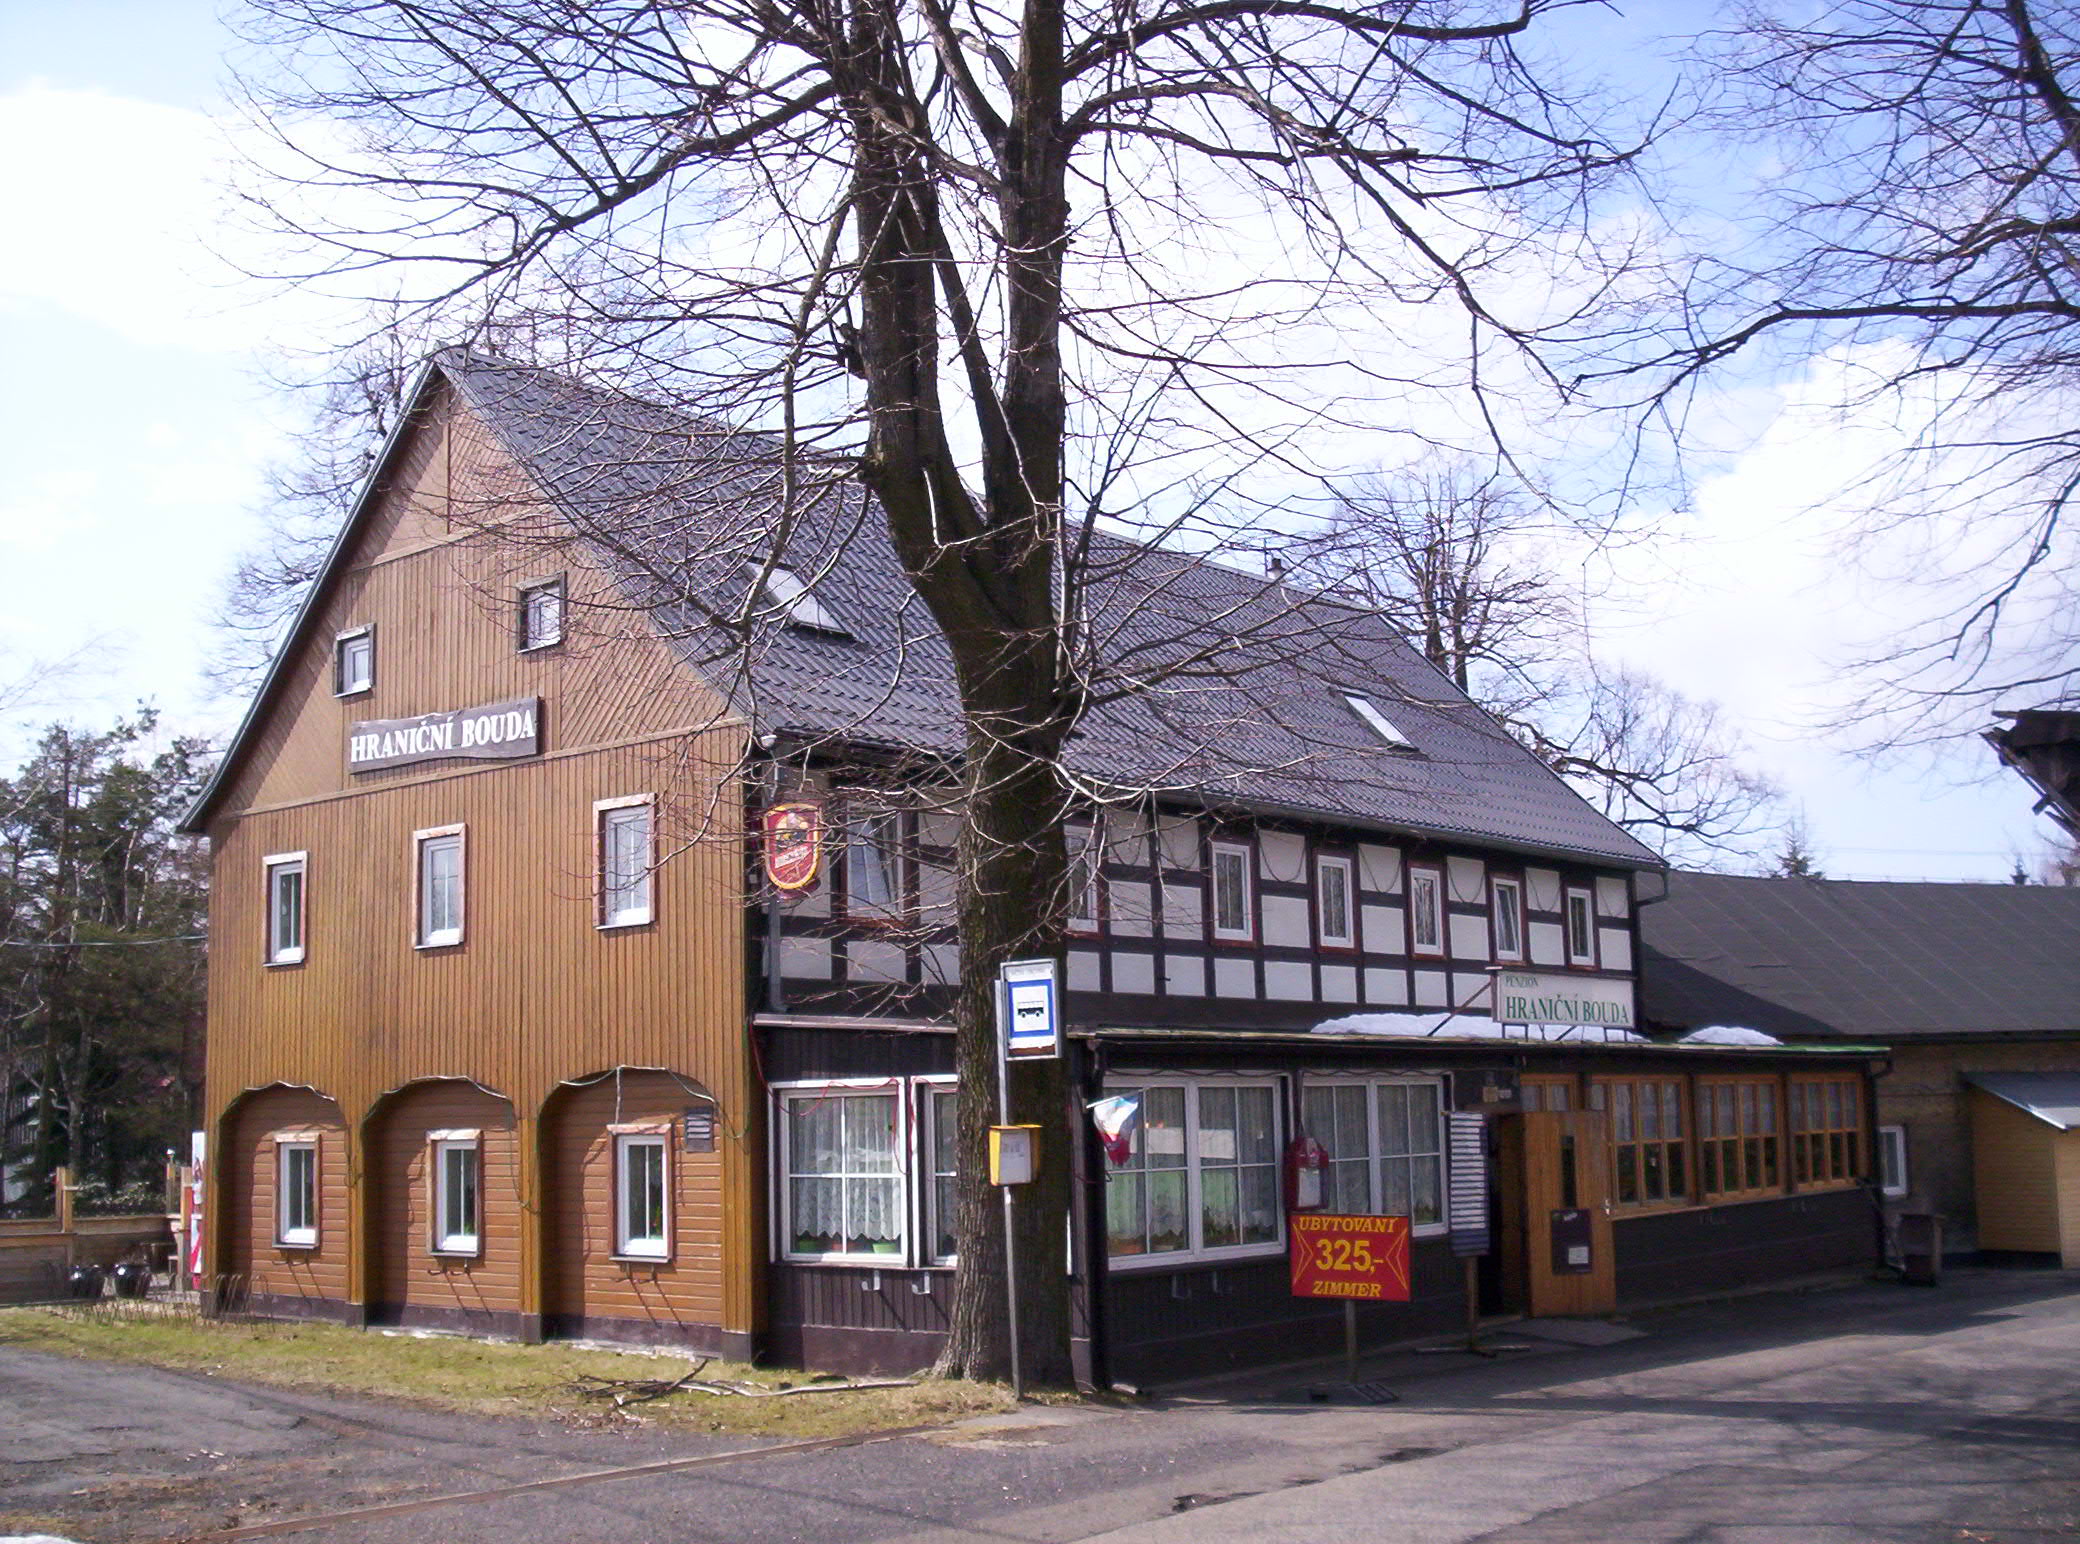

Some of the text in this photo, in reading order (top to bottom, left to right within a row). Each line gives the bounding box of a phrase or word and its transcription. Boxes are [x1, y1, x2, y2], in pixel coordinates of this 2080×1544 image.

[351, 709, 535, 762] HRANIČNÍ BOUDA
[1506, 994, 1629, 1023] HRANIČNÍ BOUDA
[1312, 1281, 1382, 1297] ZIMMER
